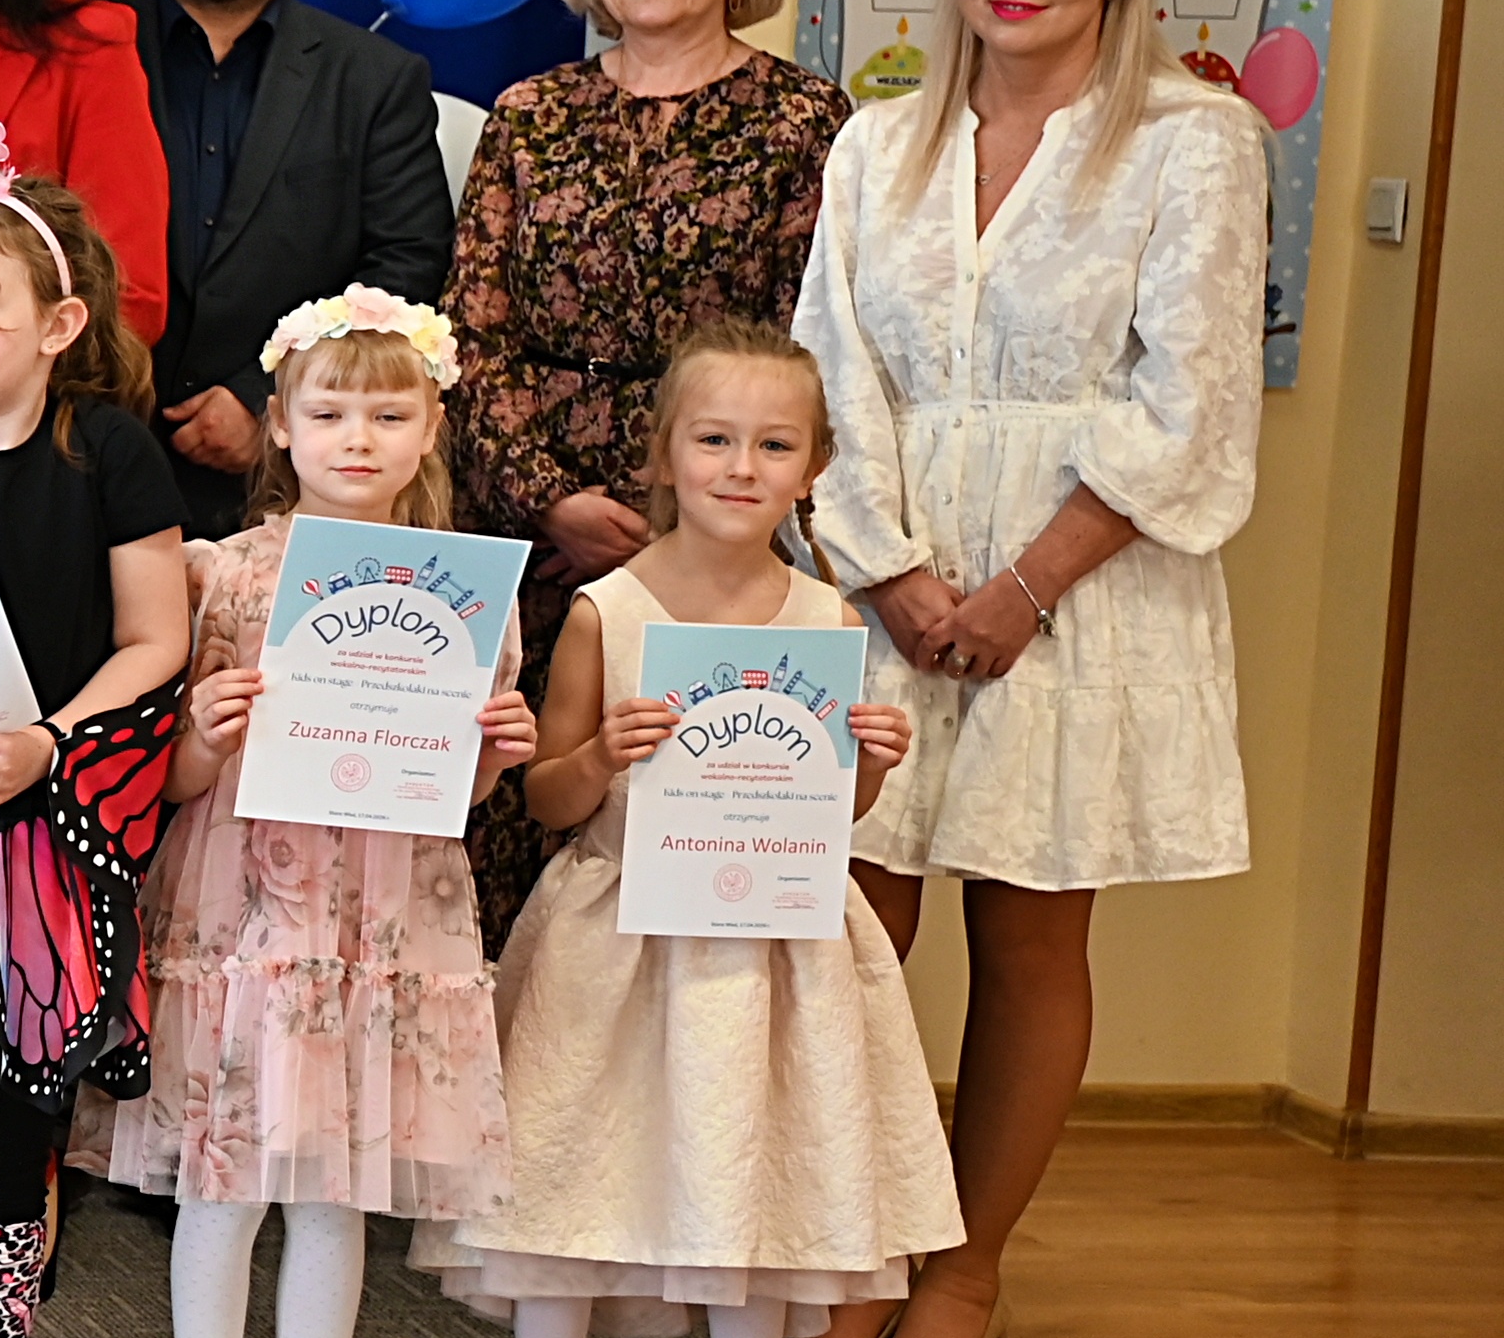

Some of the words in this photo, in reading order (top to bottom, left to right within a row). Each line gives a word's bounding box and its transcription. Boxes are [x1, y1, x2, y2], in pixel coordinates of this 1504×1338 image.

[311, 598, 449, 655] Dyplom
[349, 649, 373, 659] udział
[384, 653, 424, 663] konkursie
[331, 660, 426, 674] wokalno-recytatorskim
[291, 671, 312, 682] Kids
[328, 677, 354, 690] stage
[362, 678, 426, 693] Przedszkolaki
[441, 687, 472, 698] scenie
[350, 701, 398, 715] otrzymuje
[288, 721, 367, 744] Zuzanna
[374, 730, 451, 752] Florczak
[678, 704, 811, 761] Dyplom
[701, 773, 793, 783] wokalno-recytatorskim
[664, 787, 683, 796] Kids
[700, 790, 724, 801] stage
[732, 789, 793, 799] Przedszkolaki
[809, 792, 838, 800] scenie
[724, 813, 769, 823] otrzymuje
[661, 835, 745, 853] Antonina
[752, 838, 827, 855] Wolanin
